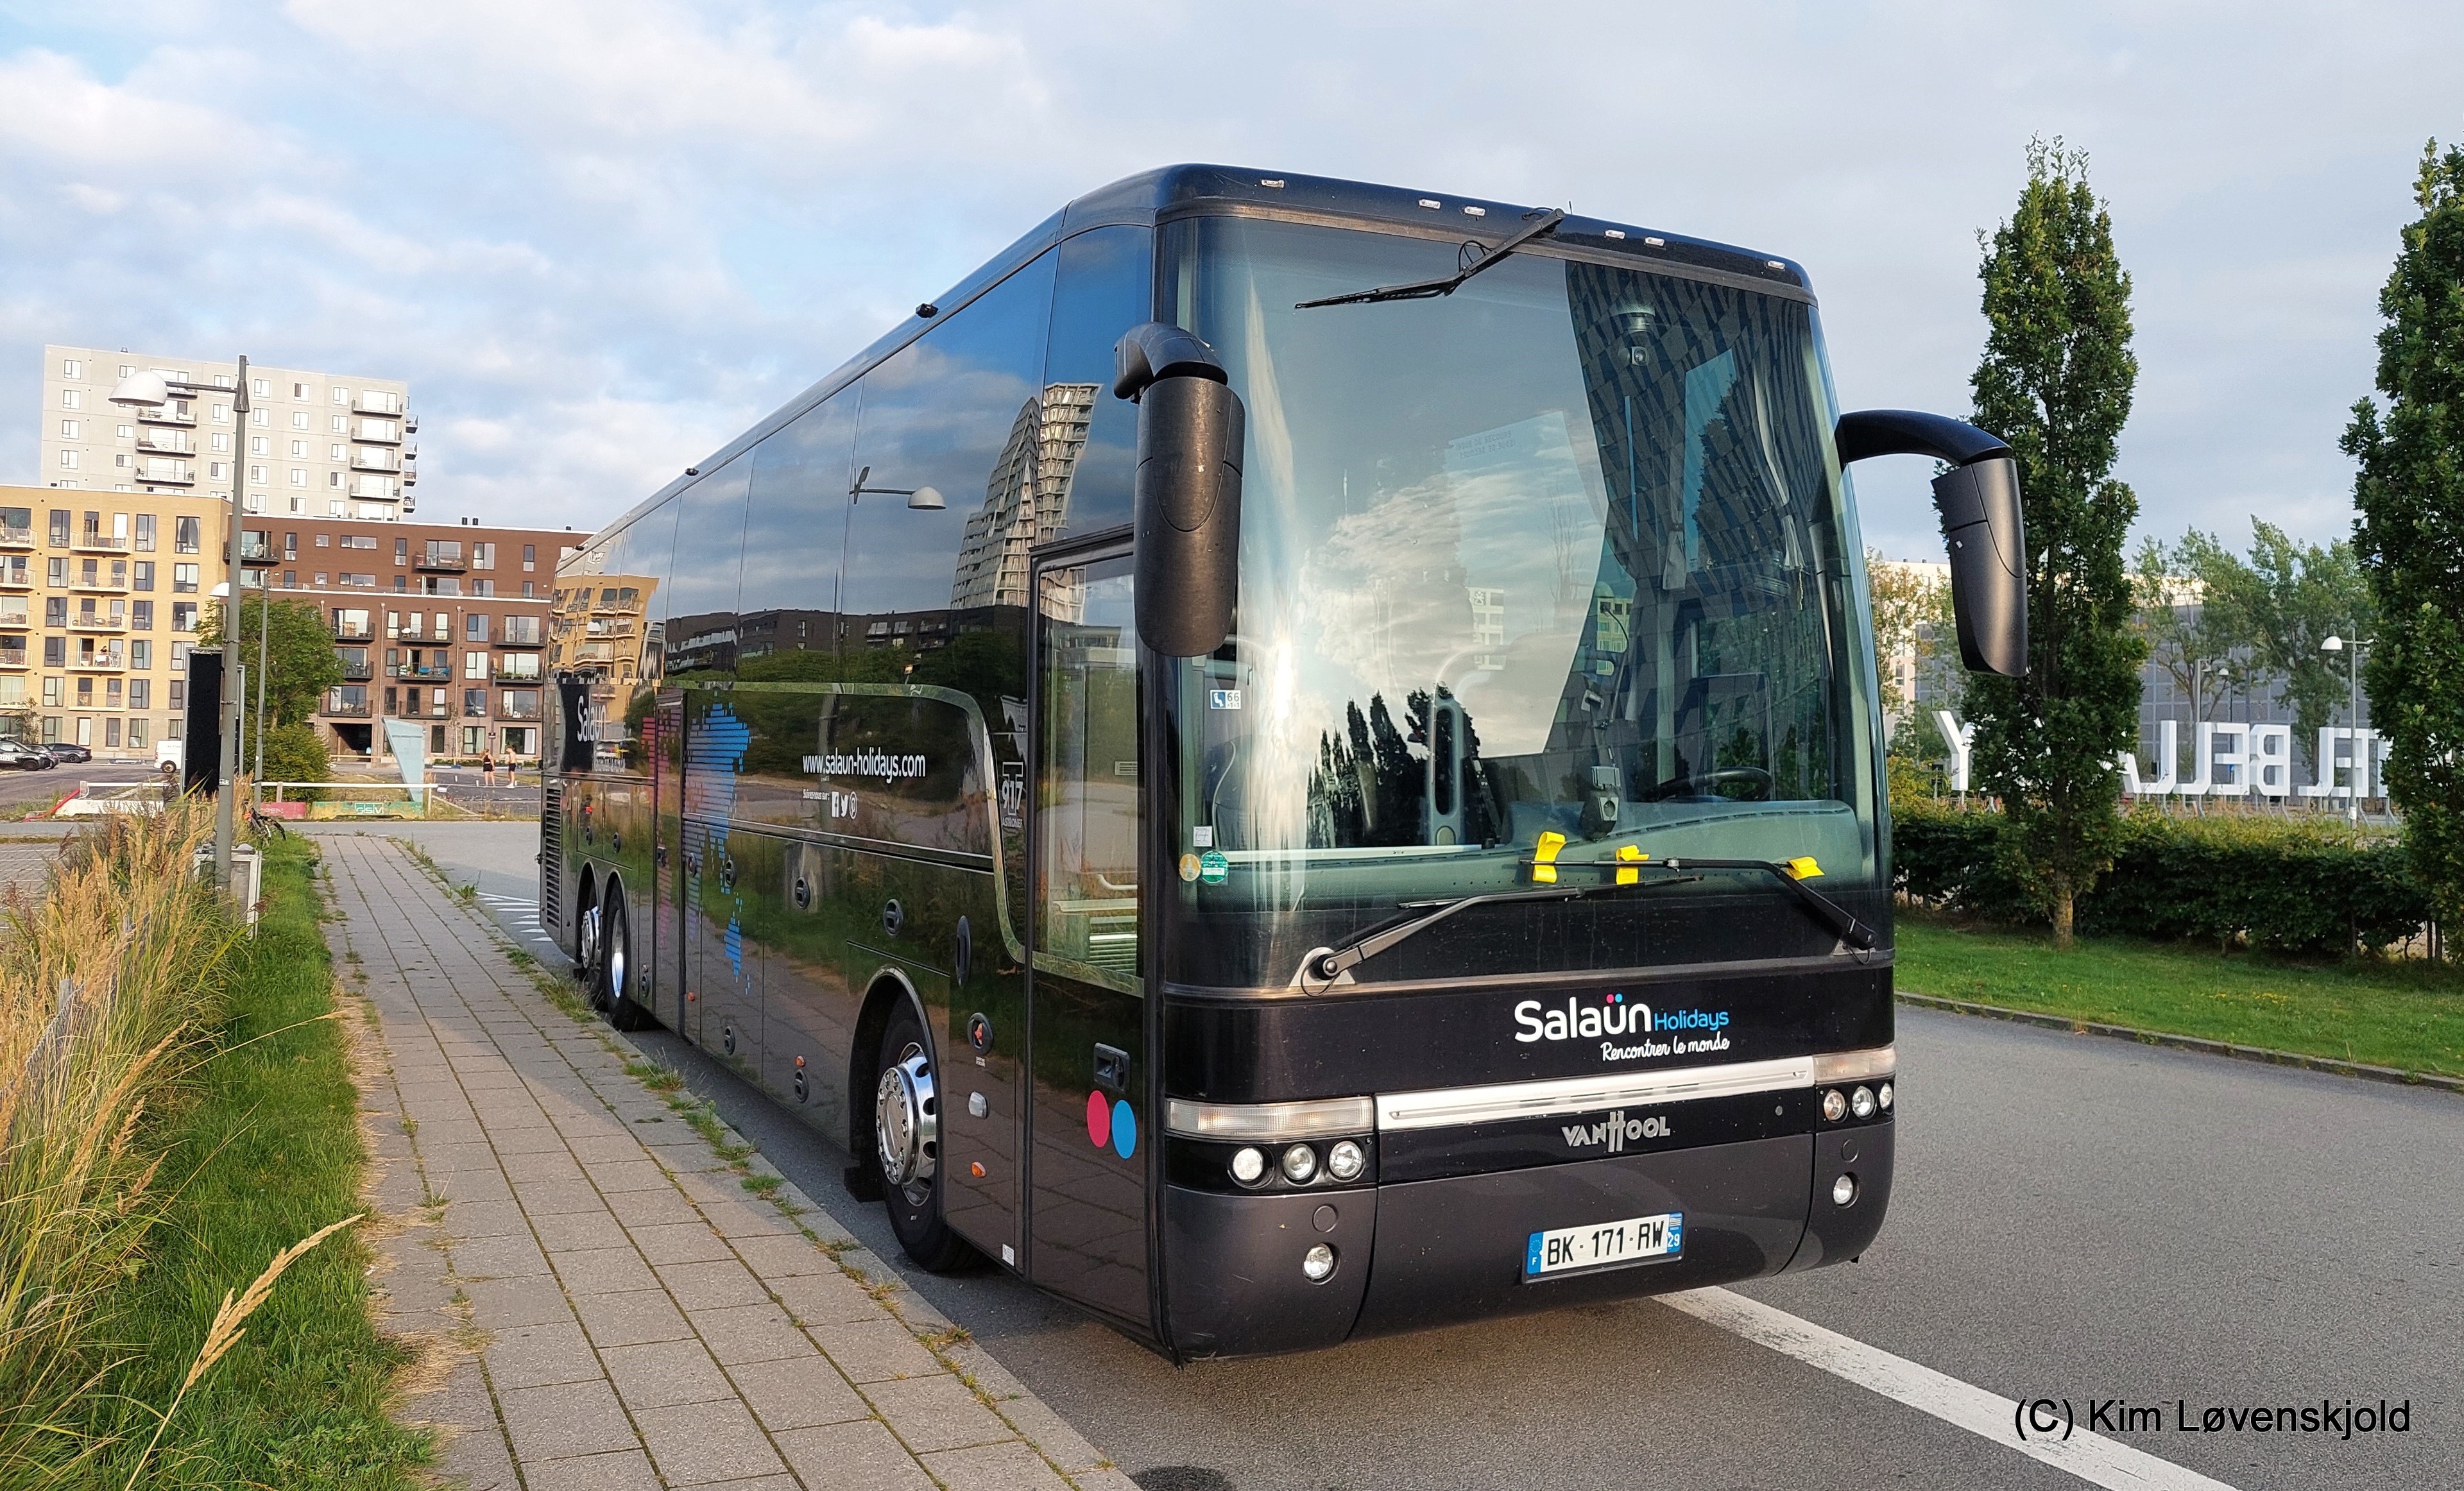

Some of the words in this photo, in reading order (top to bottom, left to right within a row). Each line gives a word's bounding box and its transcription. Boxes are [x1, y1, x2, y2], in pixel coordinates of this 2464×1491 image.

[1228, 692, 1239, 702] 66
[803, 747, 925, 783] www.salaun-holidays.com
[1514, 993, 1651, 1043] Salaün
[1654, 1009, 1729, 1031] Holidays
[1600, 1038, 1671, 1061] Rencontrer
[1673, 1035, 1686, 1054] le
[1688, 1031, 1730, 1053] monde
[1532, 1256, 1537, 1266] F
[1668, 1232, 1680, 1247] 29
